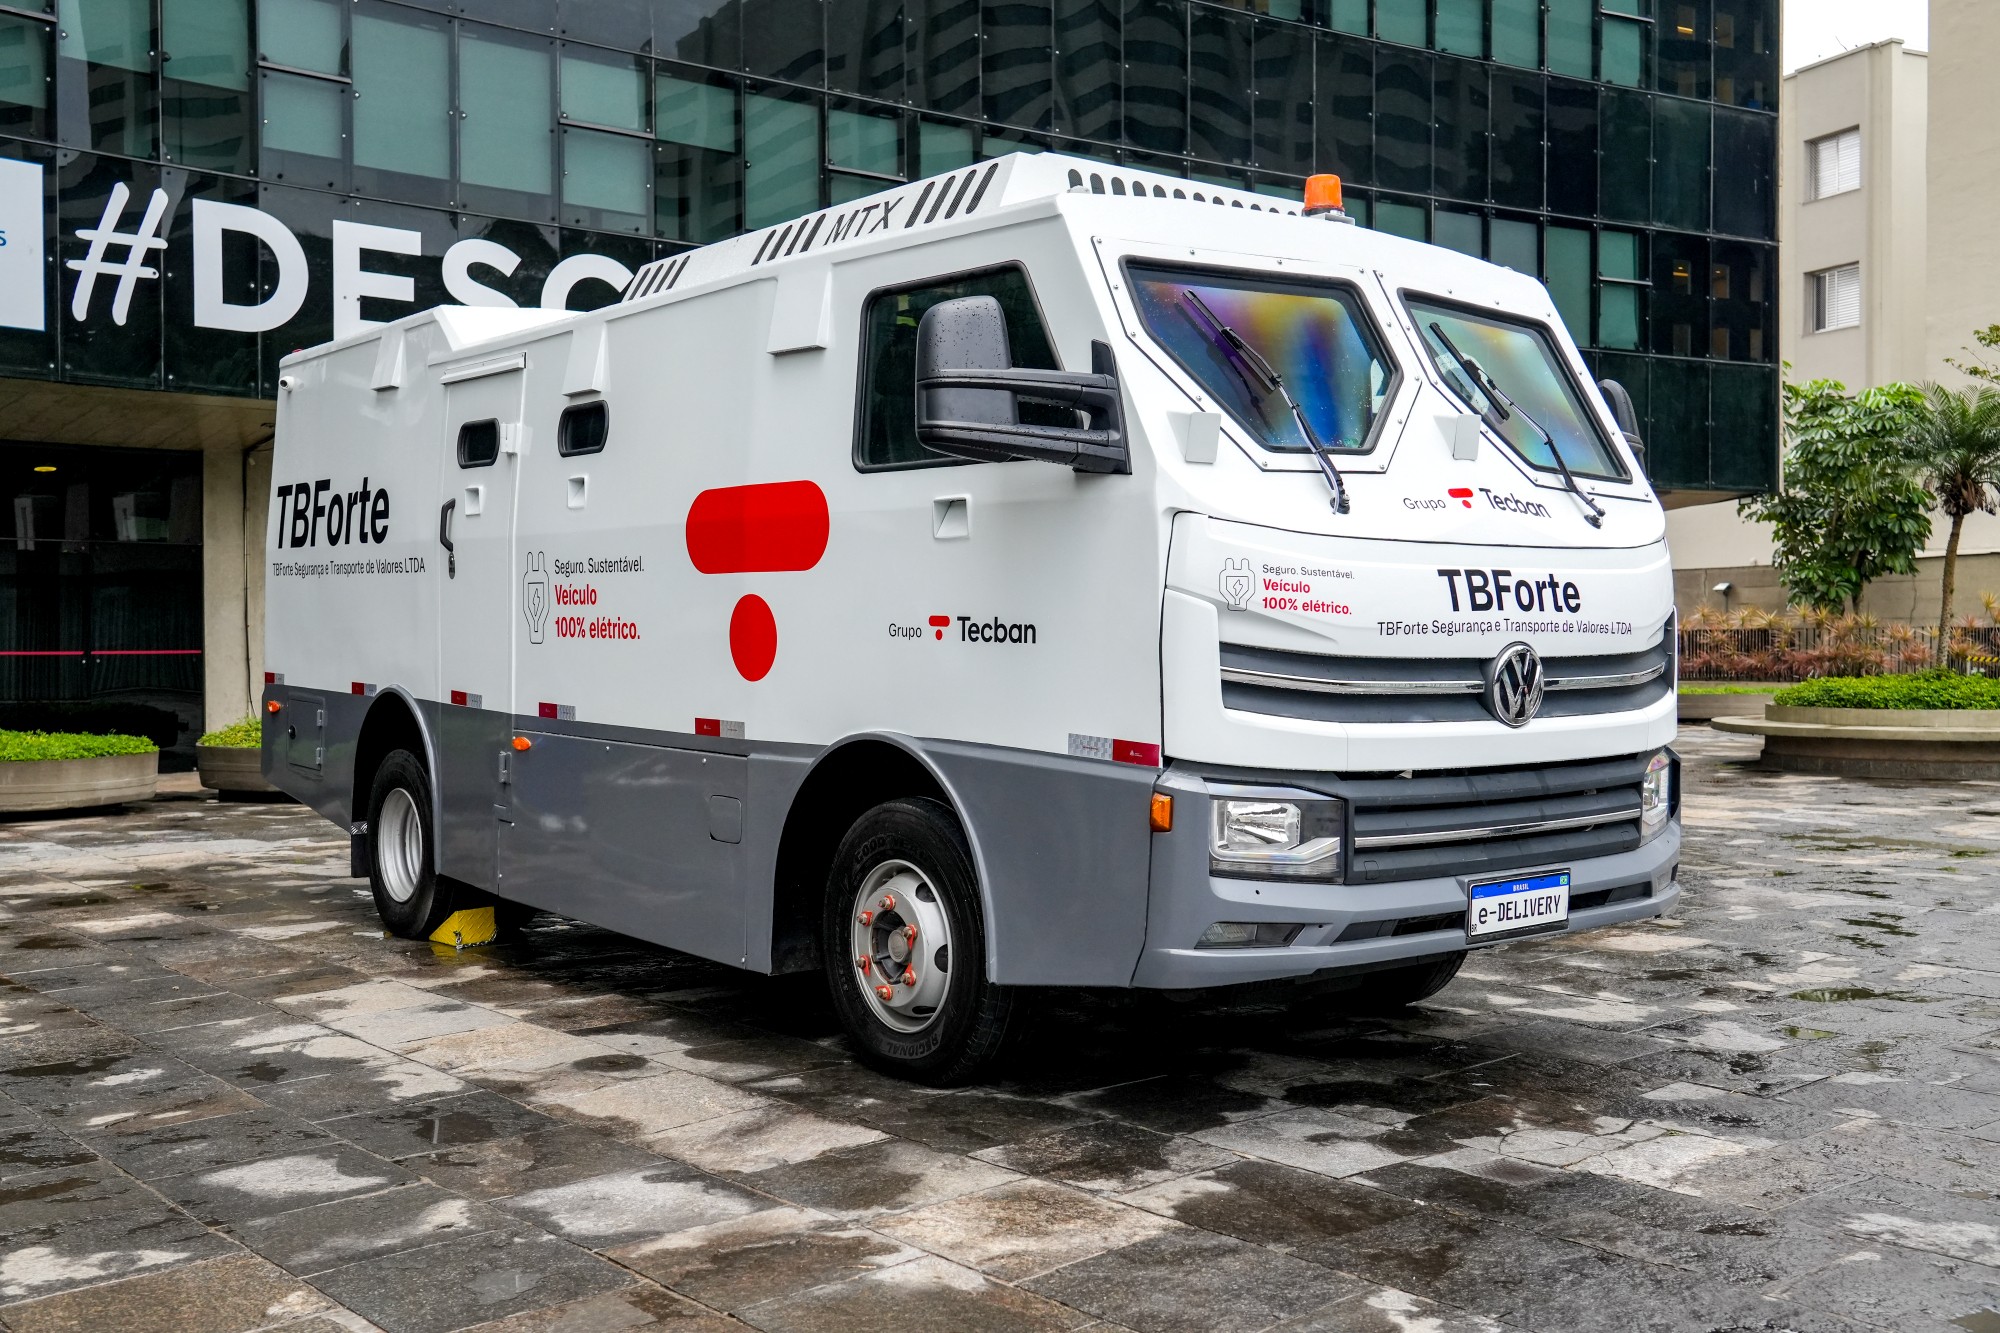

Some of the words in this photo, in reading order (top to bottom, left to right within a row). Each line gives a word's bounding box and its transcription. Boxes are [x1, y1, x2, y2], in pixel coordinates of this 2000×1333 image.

[823, 196, 904, 246] MTX
[277, 476, 390, 549] TBForte
[1403, 497, 1447, 511] Grupo
[1478, 487, 1552, 518] Tecban
[273, 562, 294, 577] TBForte
[294, 562, 325, 579] Segurança
[330, 560, 365, 578] Transporte
[365, 559, 375, 574] de
[375, 558, 403, 574] Valores
[404, 557, 426, 574] LTDA
[554, 558, 586, 578] Seguro.
[588, 555, 645, 574] Sustentável.
[1262, 563, 1299, 576] Seguro.
[1300, 566, 1355, 580] Sustentável.
[554, 583, 598, 606] Veículo
[1263, 578, 1311, 594] Veículo
[1437, 569, 1581, 614] TBForte
[1262, 596, 1298, 611] 100%
[1302, 599, 1352, 615] elétrico.
[555, 616, 586, 638] 100%
[589, 616, 641, 640] elétrico.
[888, 623, 922, 640] Grupo
[956, 616, 1037, 644] Tecban
[1377, 621, 1429, 636] TBForte
[1431, 619, 1493, 637] Segurança
[1494, 620, 1501, 632] e
[1503, 618, 1560, 635] Transporte
[1562, 619, 1574, 633] de
[1576, 620, 1609, 634] Valores
[1610, 621, 1632, 635] LTDA
[1512, 882, 1530, 892] BRASIL
[1478, 894, 1561, 925] e-DELIVERY
